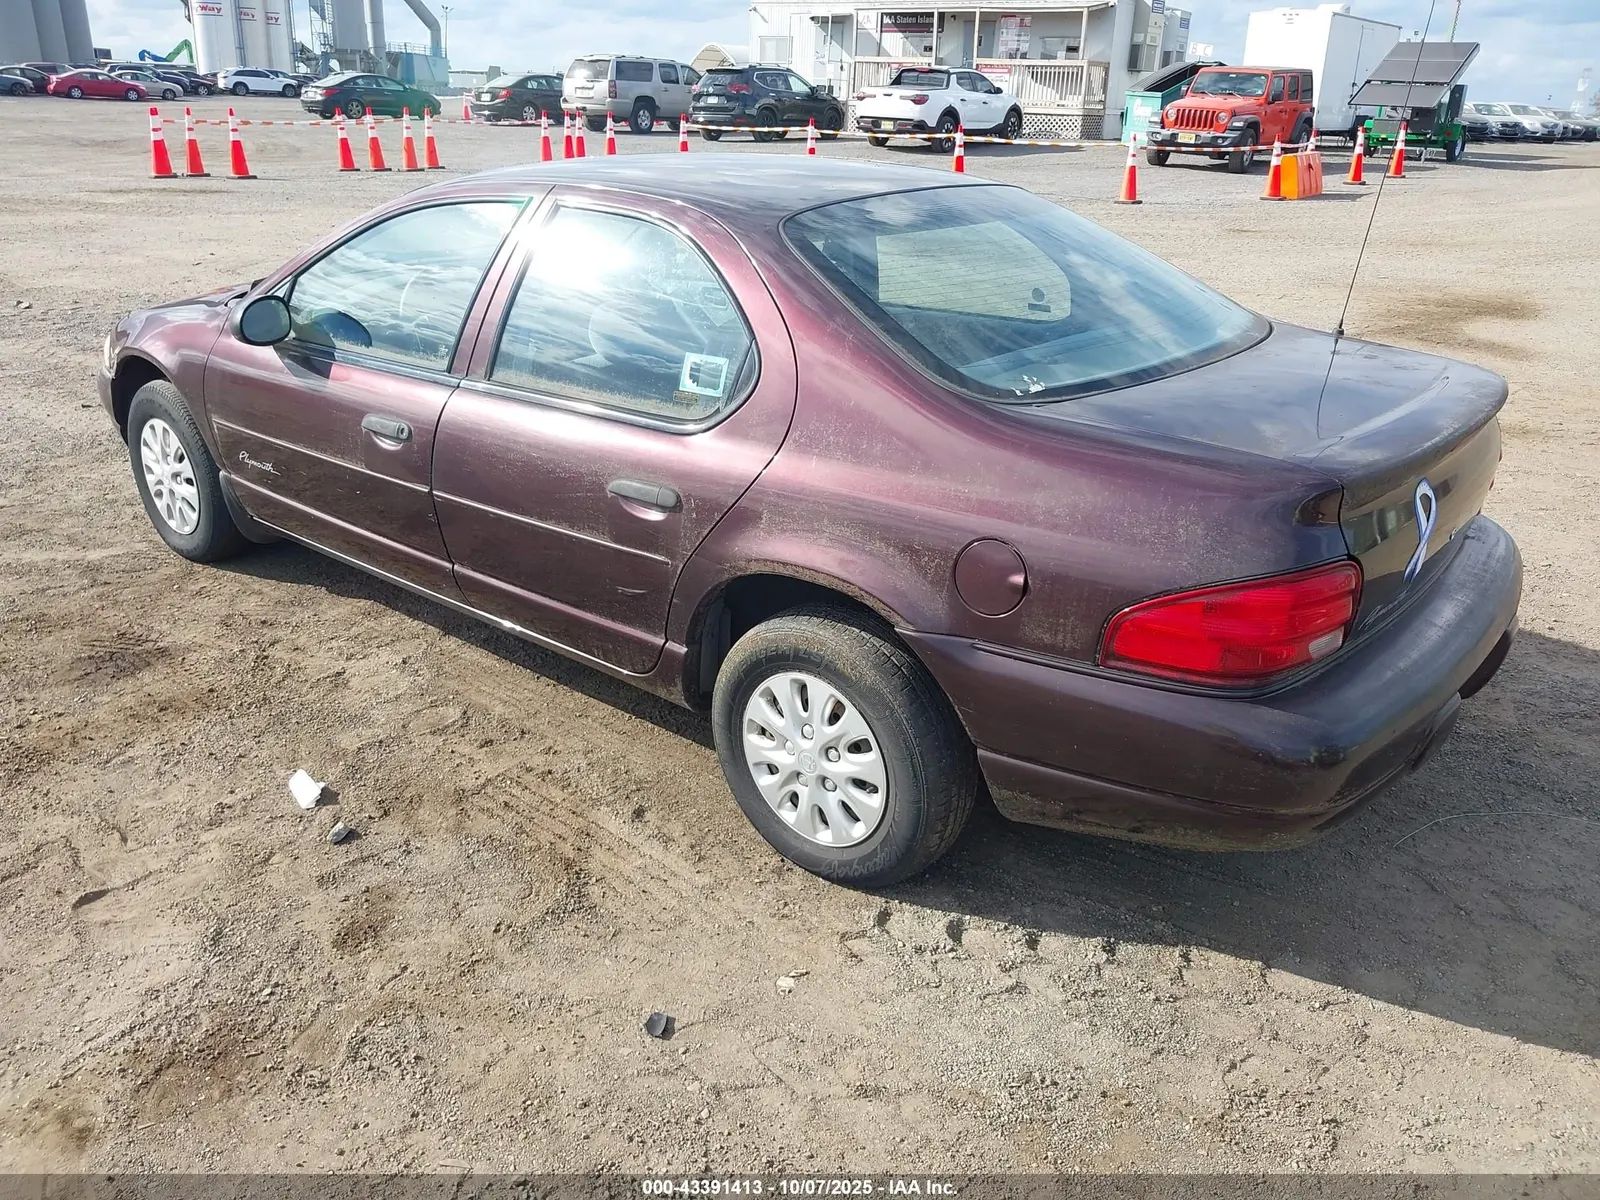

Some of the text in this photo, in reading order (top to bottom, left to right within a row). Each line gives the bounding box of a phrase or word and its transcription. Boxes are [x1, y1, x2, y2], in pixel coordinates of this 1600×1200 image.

[896, 15, 917, 24] Staten
[917, 15, 935, 24] Islan
[239, 450, 280, 475] Plymouth
